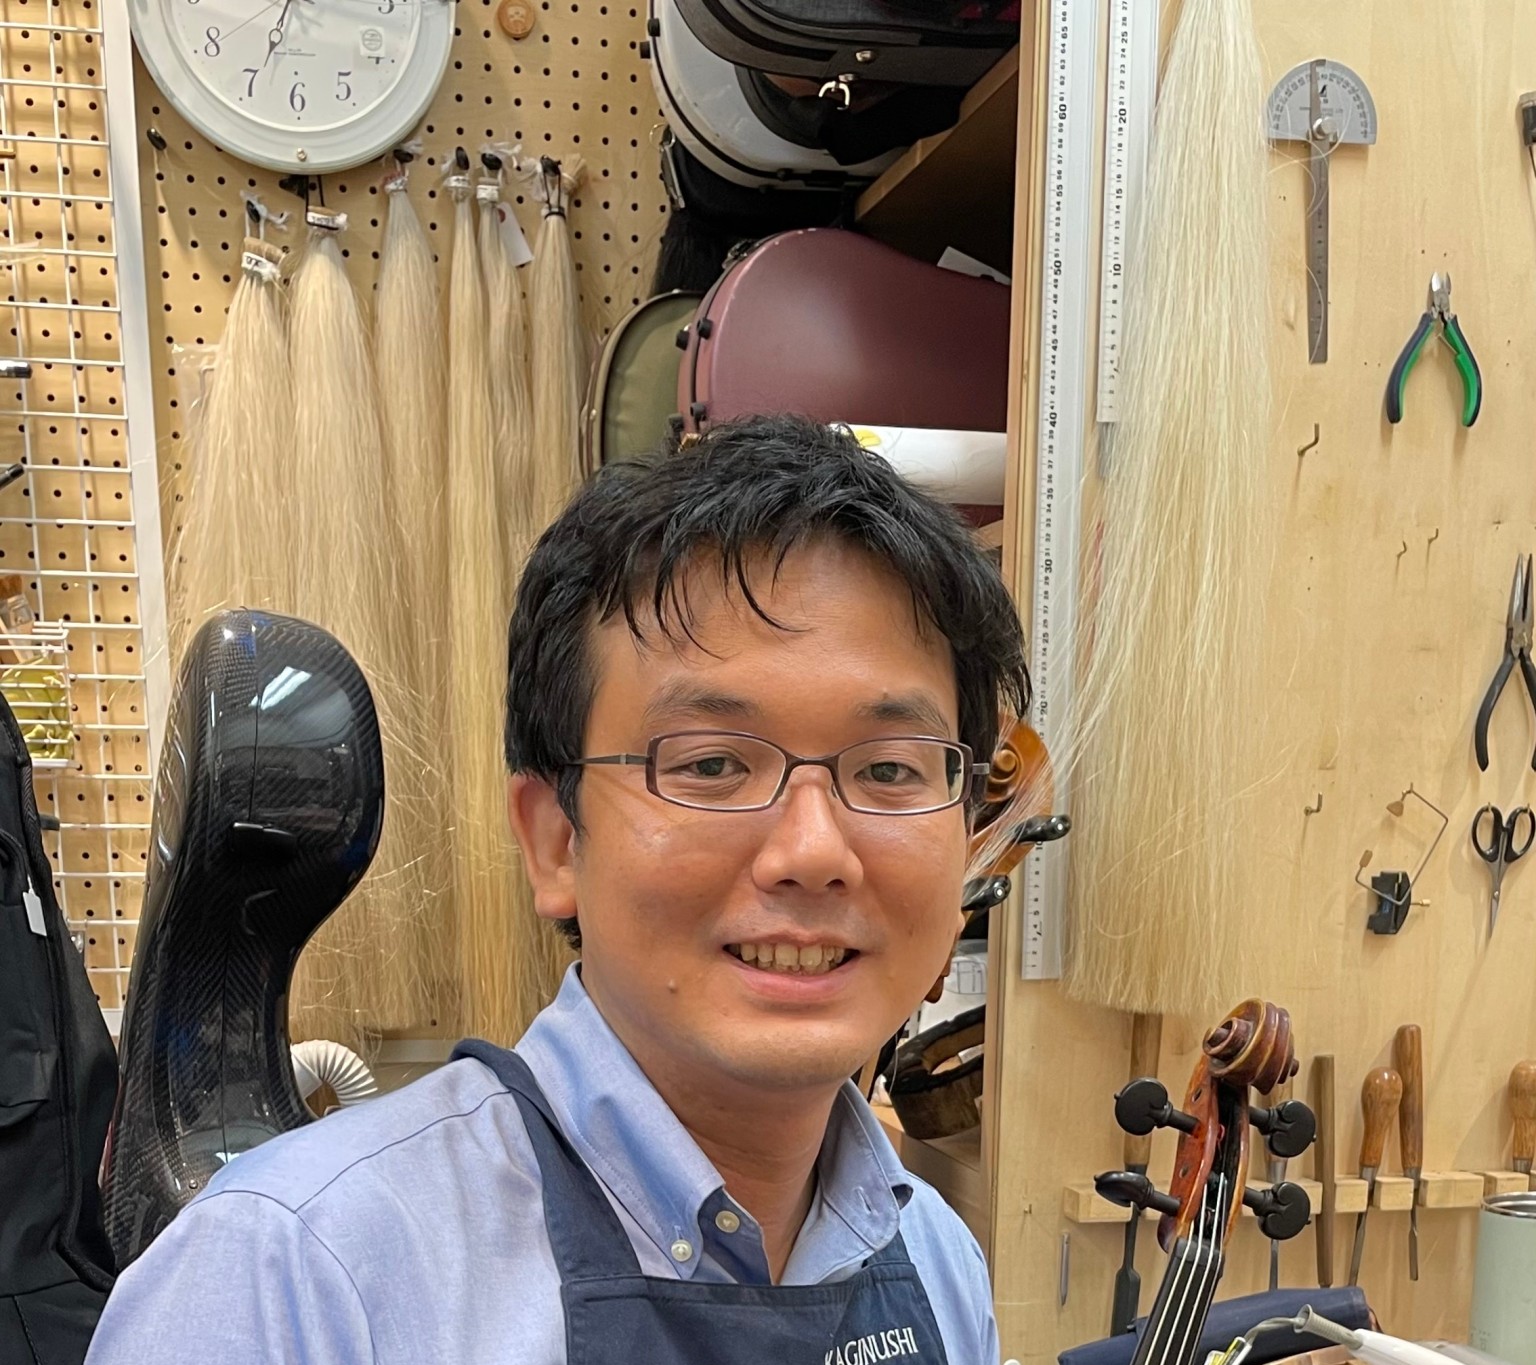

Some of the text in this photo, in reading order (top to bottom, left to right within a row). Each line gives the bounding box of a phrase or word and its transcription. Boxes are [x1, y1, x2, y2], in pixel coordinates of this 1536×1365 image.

[1122, 1, 1127, 10] 27
[1122, 16, 1127, 26] 26
[1061, 26, 1068, 39] 65
[1121, 31, 1128, 44] 25
[204, 26, 220, 58] 8
[1121, 48, 1126, 58] 24
[1120, 64, 1125, 74] 23
[242, 68, 260, 98] 7
[335, 71, 352, 102] 5
[1119, 80, 1125, 90] 22
[289, 82, 306, 113] 6
[1119, 96, 1124, 105] 21
[1059, 104, 1067, 120] 60
[1118, 108, 1126, 124] 20
[1118, 127, 1123, 136] 19
[1117, 143, 1123, 151] 18
[1116, 158, 1122, 167] 17
[1116, 174, 1122, 183] 16
[1056, 184, 1063, 197] 55
[1116, 188, 1123, 199] 15
[1115, 205, 1120, 214] 14
[1114, 220, 1120, 229] 13
[1114, 236, 1120, 244] 12
[1113, 251, 1119, 260] 11
[1054, 260, 1062, 275] 50
[1113, 263, 1121, 276] 10
[1051, 338, 1058, 351] 45
[1049, 412, 1057, 427] 40
[1046, 488, 1054, 499] 35
[1044, 559, 1052, 573] 30
